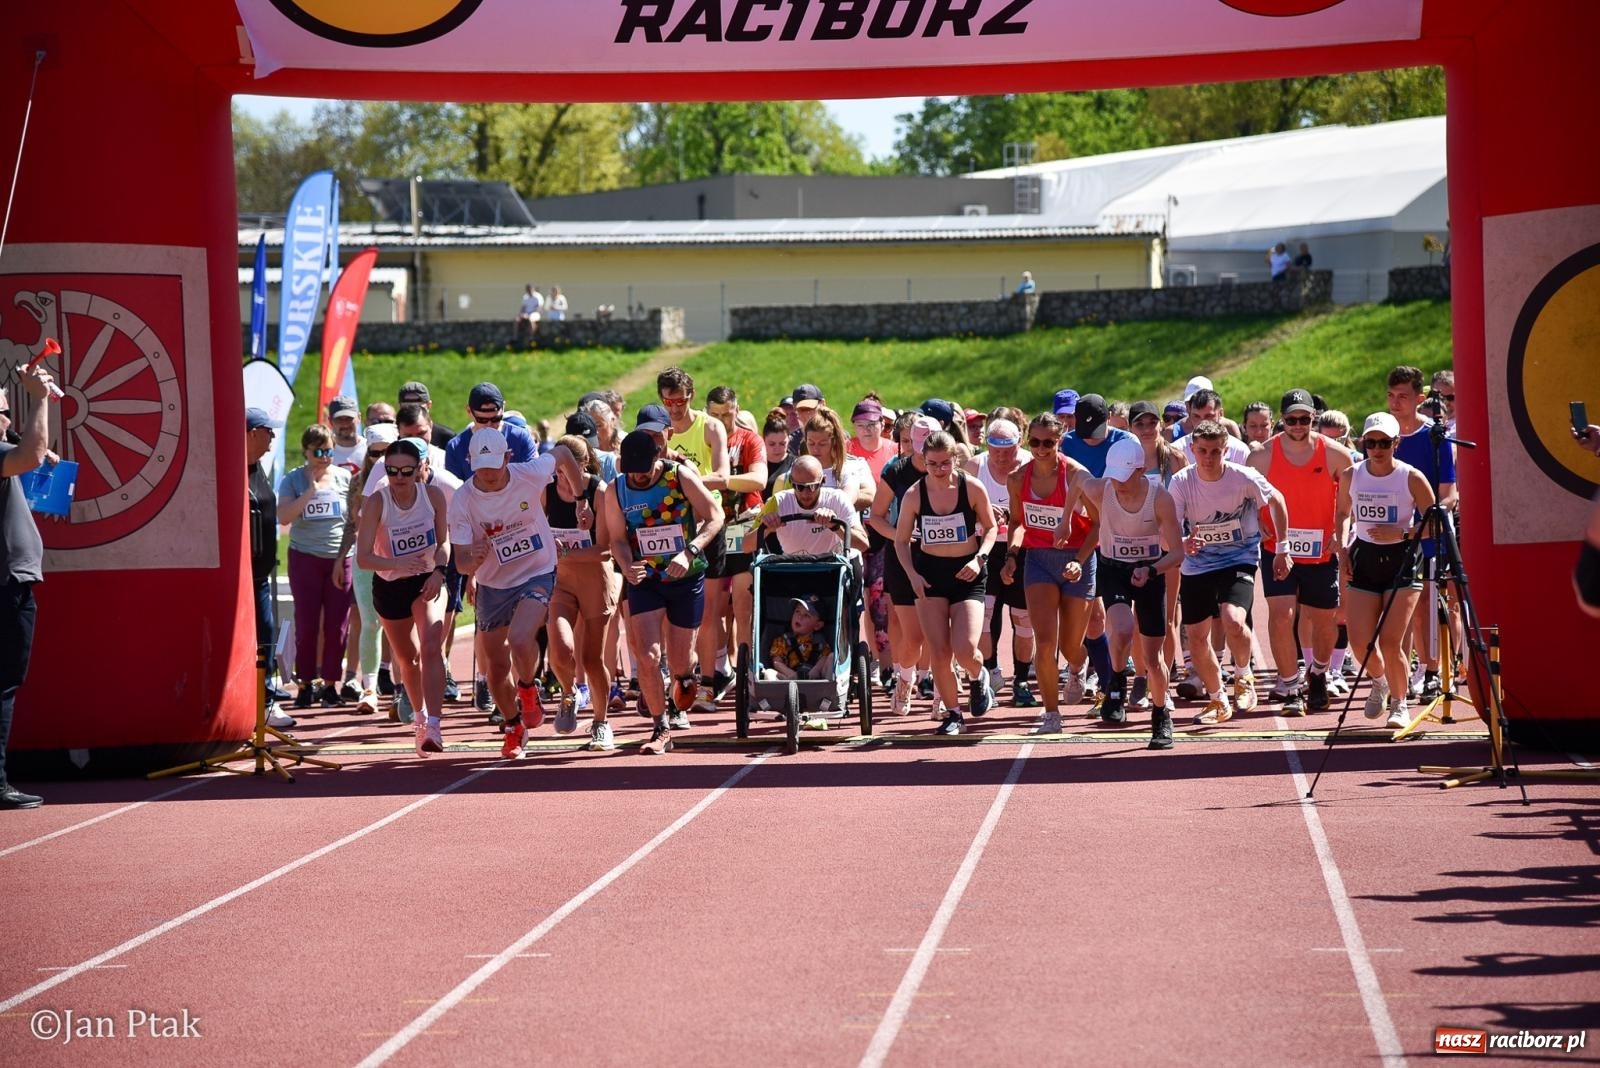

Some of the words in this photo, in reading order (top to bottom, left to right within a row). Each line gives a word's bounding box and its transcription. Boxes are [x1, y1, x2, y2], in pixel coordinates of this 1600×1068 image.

[307, 503, 330, 514] 057
[1360, 505, 1386, 518] 059
[1029, 514, 1056, 526] 058
[928, 528, 955, 540] 038
[1203, 532, 1230, 542] 033
[397, 534, 425, 551] 062
[501, 539, 530, 558] 043
[647, 538, 670, 551] 071
[1119, 546, 1145, 556] 051
